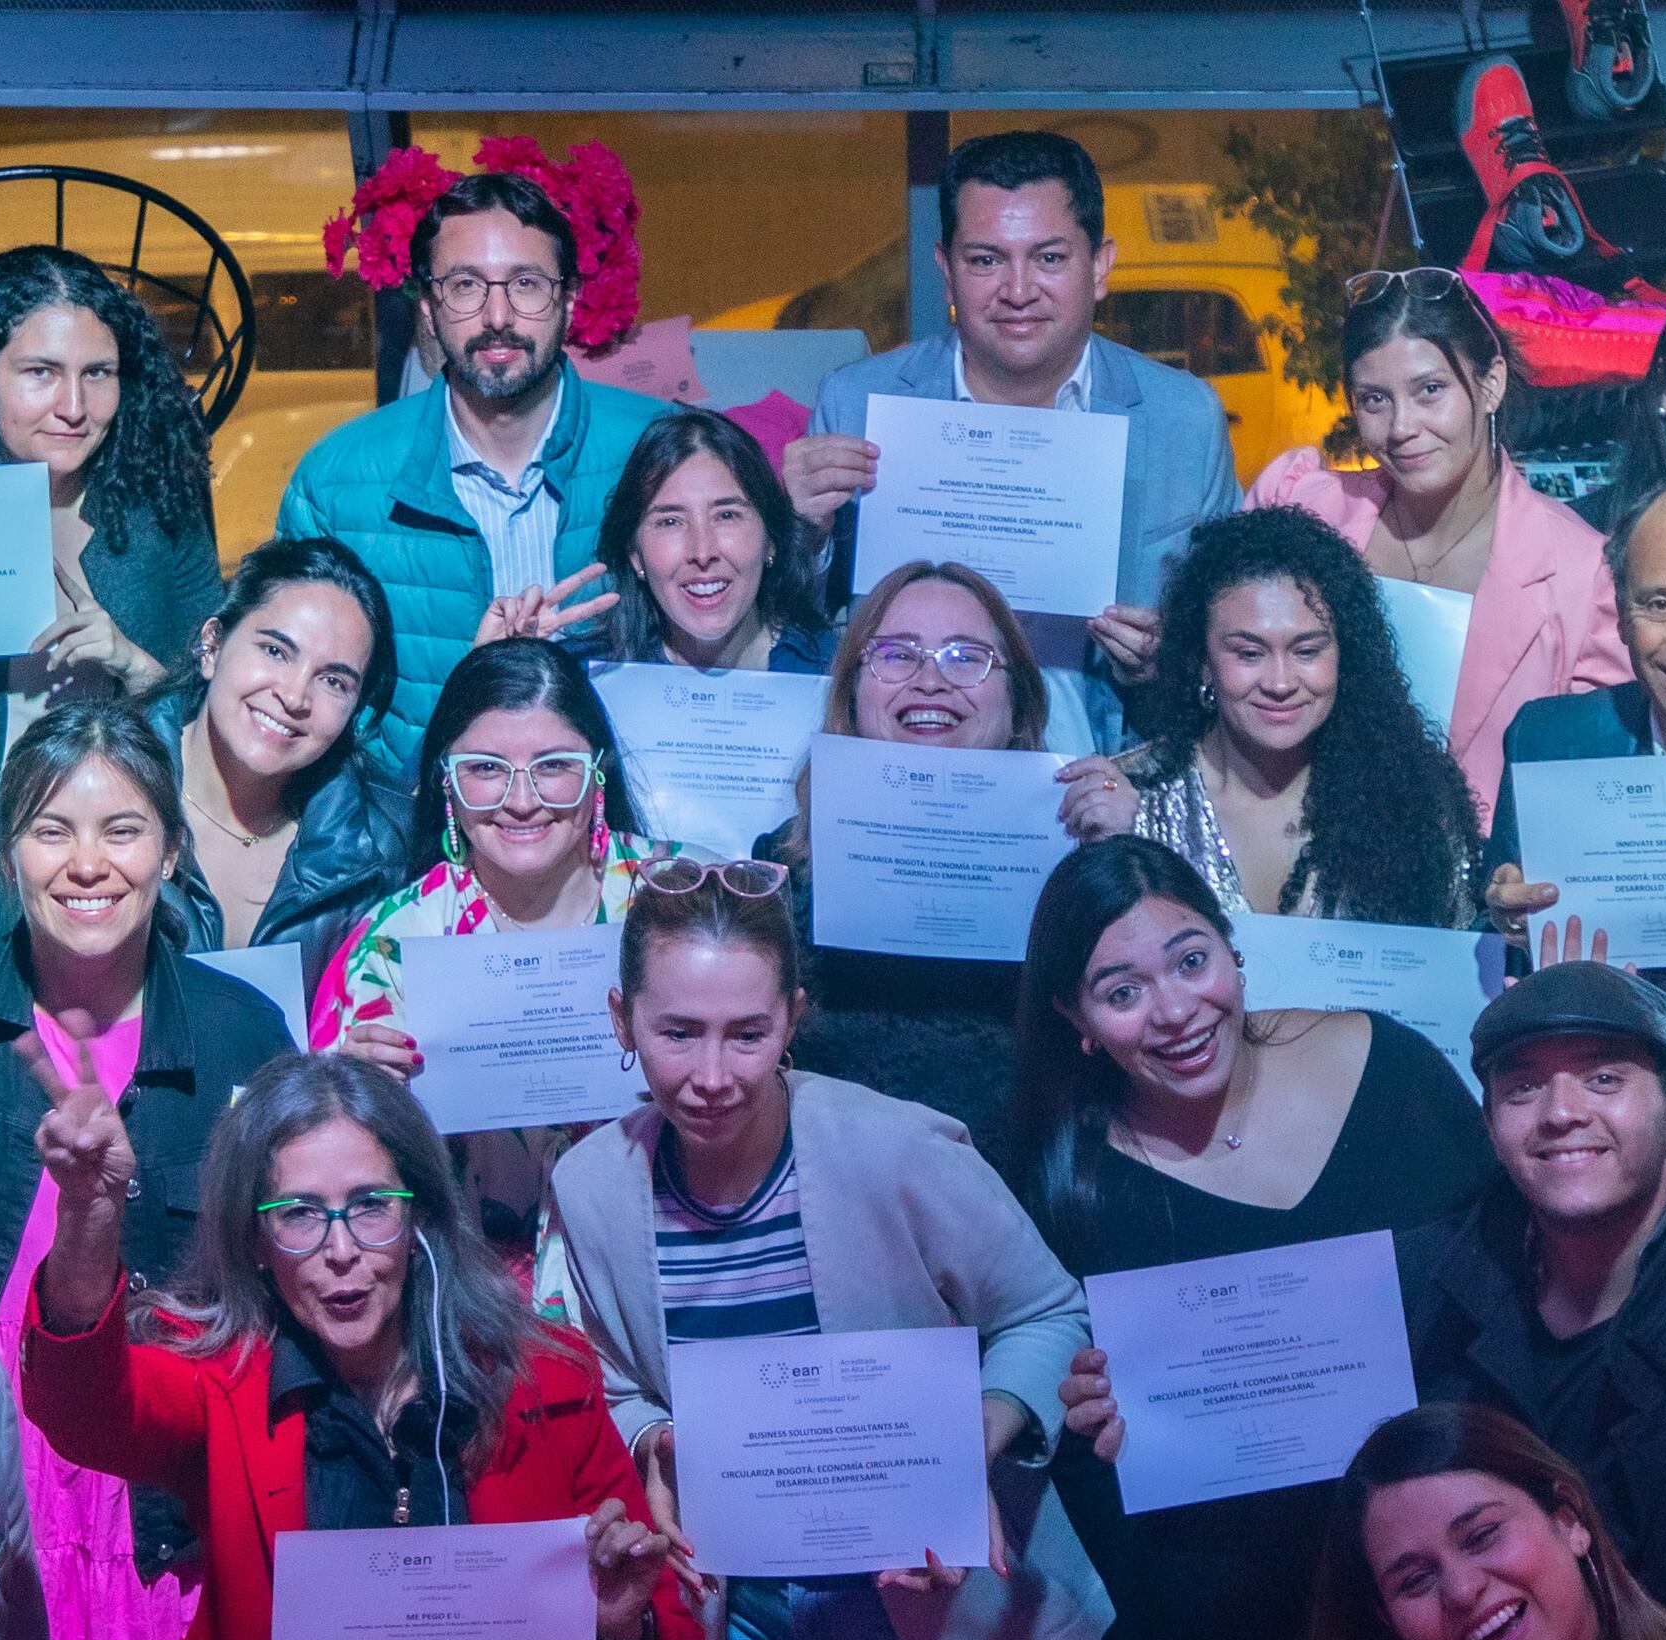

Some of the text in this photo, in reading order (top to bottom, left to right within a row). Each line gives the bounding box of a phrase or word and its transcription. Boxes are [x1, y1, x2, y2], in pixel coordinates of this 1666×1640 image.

[969, 429, 993, 440] ean
[10, 568, 17, 576] EL
[1626, 784, 1652, 794] ean
[1565, 874, 1615, 883] CIRCULARIZA
[1616, 871, 1651, 882] BOGOTÁ:
[514, 957, 540, 967] ean
[449, 1042, 499, 1053] CIRCULARIZA
[499, 1038, 535, 1049] BOGOTÁ:
[536, 1034, 580, 1046] ECONOMÍA
[1209, 1284, 1238, 1298] ean
[792, 1365, 820, 1377] ean
[1147, 1360, 1367, 1403] CIRCULARIZA BOGOTÁ: ECONOMÍA CIRCULAR PARA EL
[1203, 1390, 1258, 1406] DESARROLLO
[1259, 1380, 1316, 1397] EMPRESARIAL
[748, 1421, 910, 1440] BUSINESS SOLUTIONS CONSULTANTS SAS
[721, 1456, 941, 1479] CIRCULARIZA BOGOTÁ: ECONOMÍA CIRCULAR PARA EL
[775, 1472, 888, 1487] DESARROLLO EMPRESARIAL
[403, 1554, 432, 1567] ean
